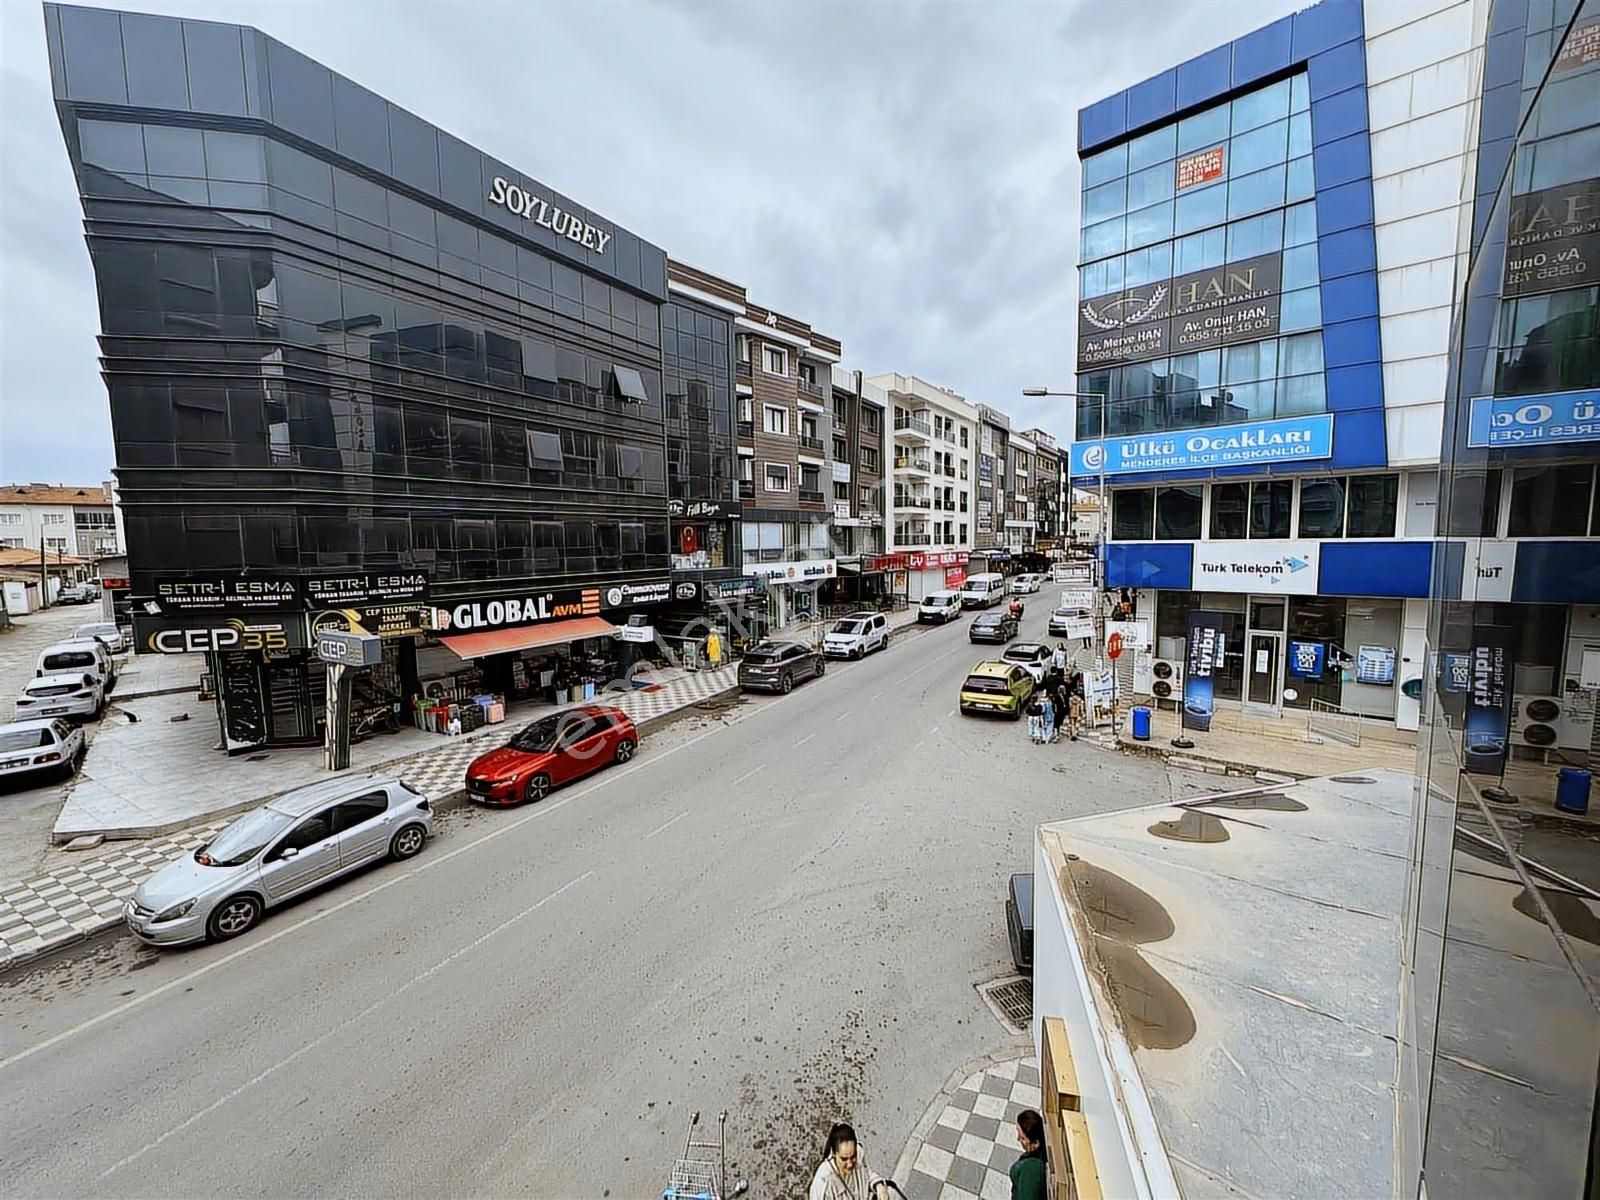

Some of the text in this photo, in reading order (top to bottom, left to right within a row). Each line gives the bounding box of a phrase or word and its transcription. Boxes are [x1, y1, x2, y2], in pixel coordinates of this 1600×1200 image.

[488, 176, 611, 254] SOYLUBEY
[1177, 267, 1256, 304] HAN
[1183, 306, 1266, 332] Av. Onur HAN
[1103, 335, 1135, 349] Merve
[1137, 327, 1162, 342] HAN
[1120, 445, 1310, 469] MENDERES İLÇE BAŞKANLIĞI
[377, 574, 427, 587] ESMA
[1201, 563, 1284, 574] Türk Telekom
[235, 581, 296, 594] ESMA
[453, 598, 582, 629] GLOBAL AVM
[156, 628, 287, 652] CEP 35
[320, 640, 347, 659] CEP
